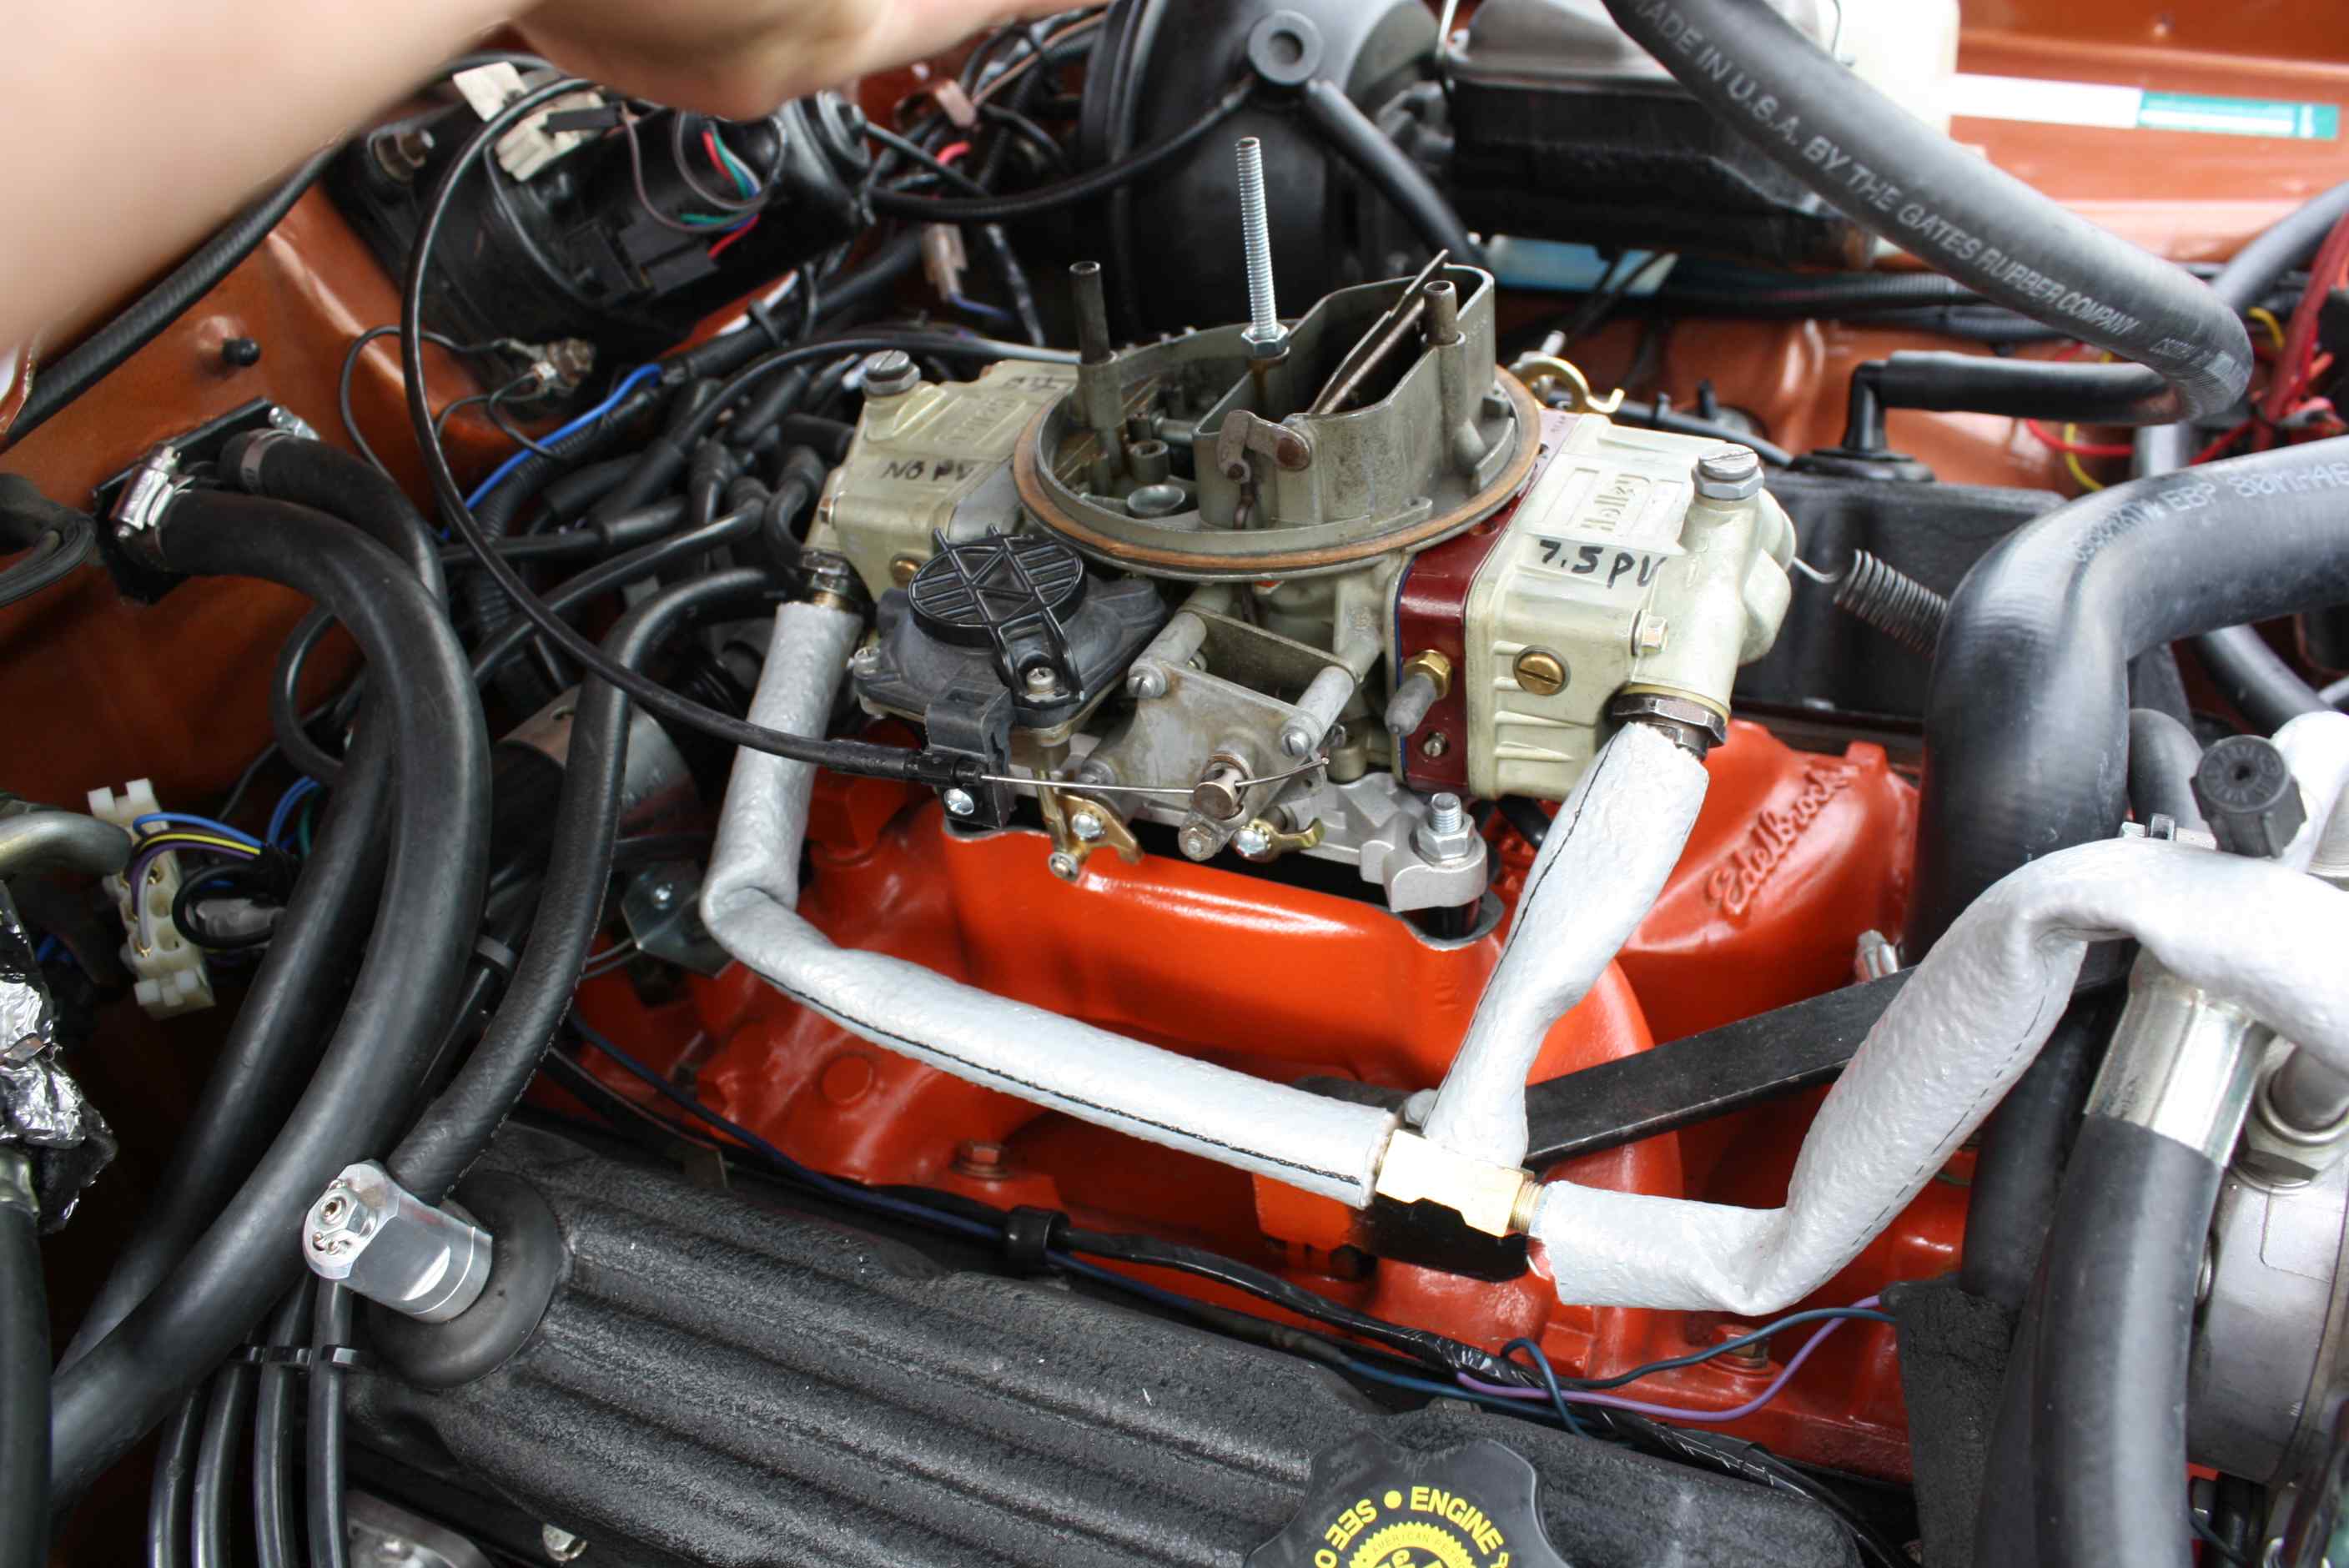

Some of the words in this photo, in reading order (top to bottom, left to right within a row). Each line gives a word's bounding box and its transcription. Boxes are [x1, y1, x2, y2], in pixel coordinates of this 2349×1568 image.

[1695, 45, 1734, 82] IN
[1727, 72, 1800, 146] U.S.A.
[1802, 135, 1851, 171] BY
[1845, 163, 1894, 212] THE
[1897, 204, 1984, 260] GATES
[1974, 247, 2066, 304] RUBBER
[2055, 291, 2142, 336] COMPANY
[881, 460, 923, 480] NO
[1539, 539, 1604, 574] 7.5
[1325, 1498, 1377, 1551] SEE
[1410, 1485, 1504, 1555] ENGINE
